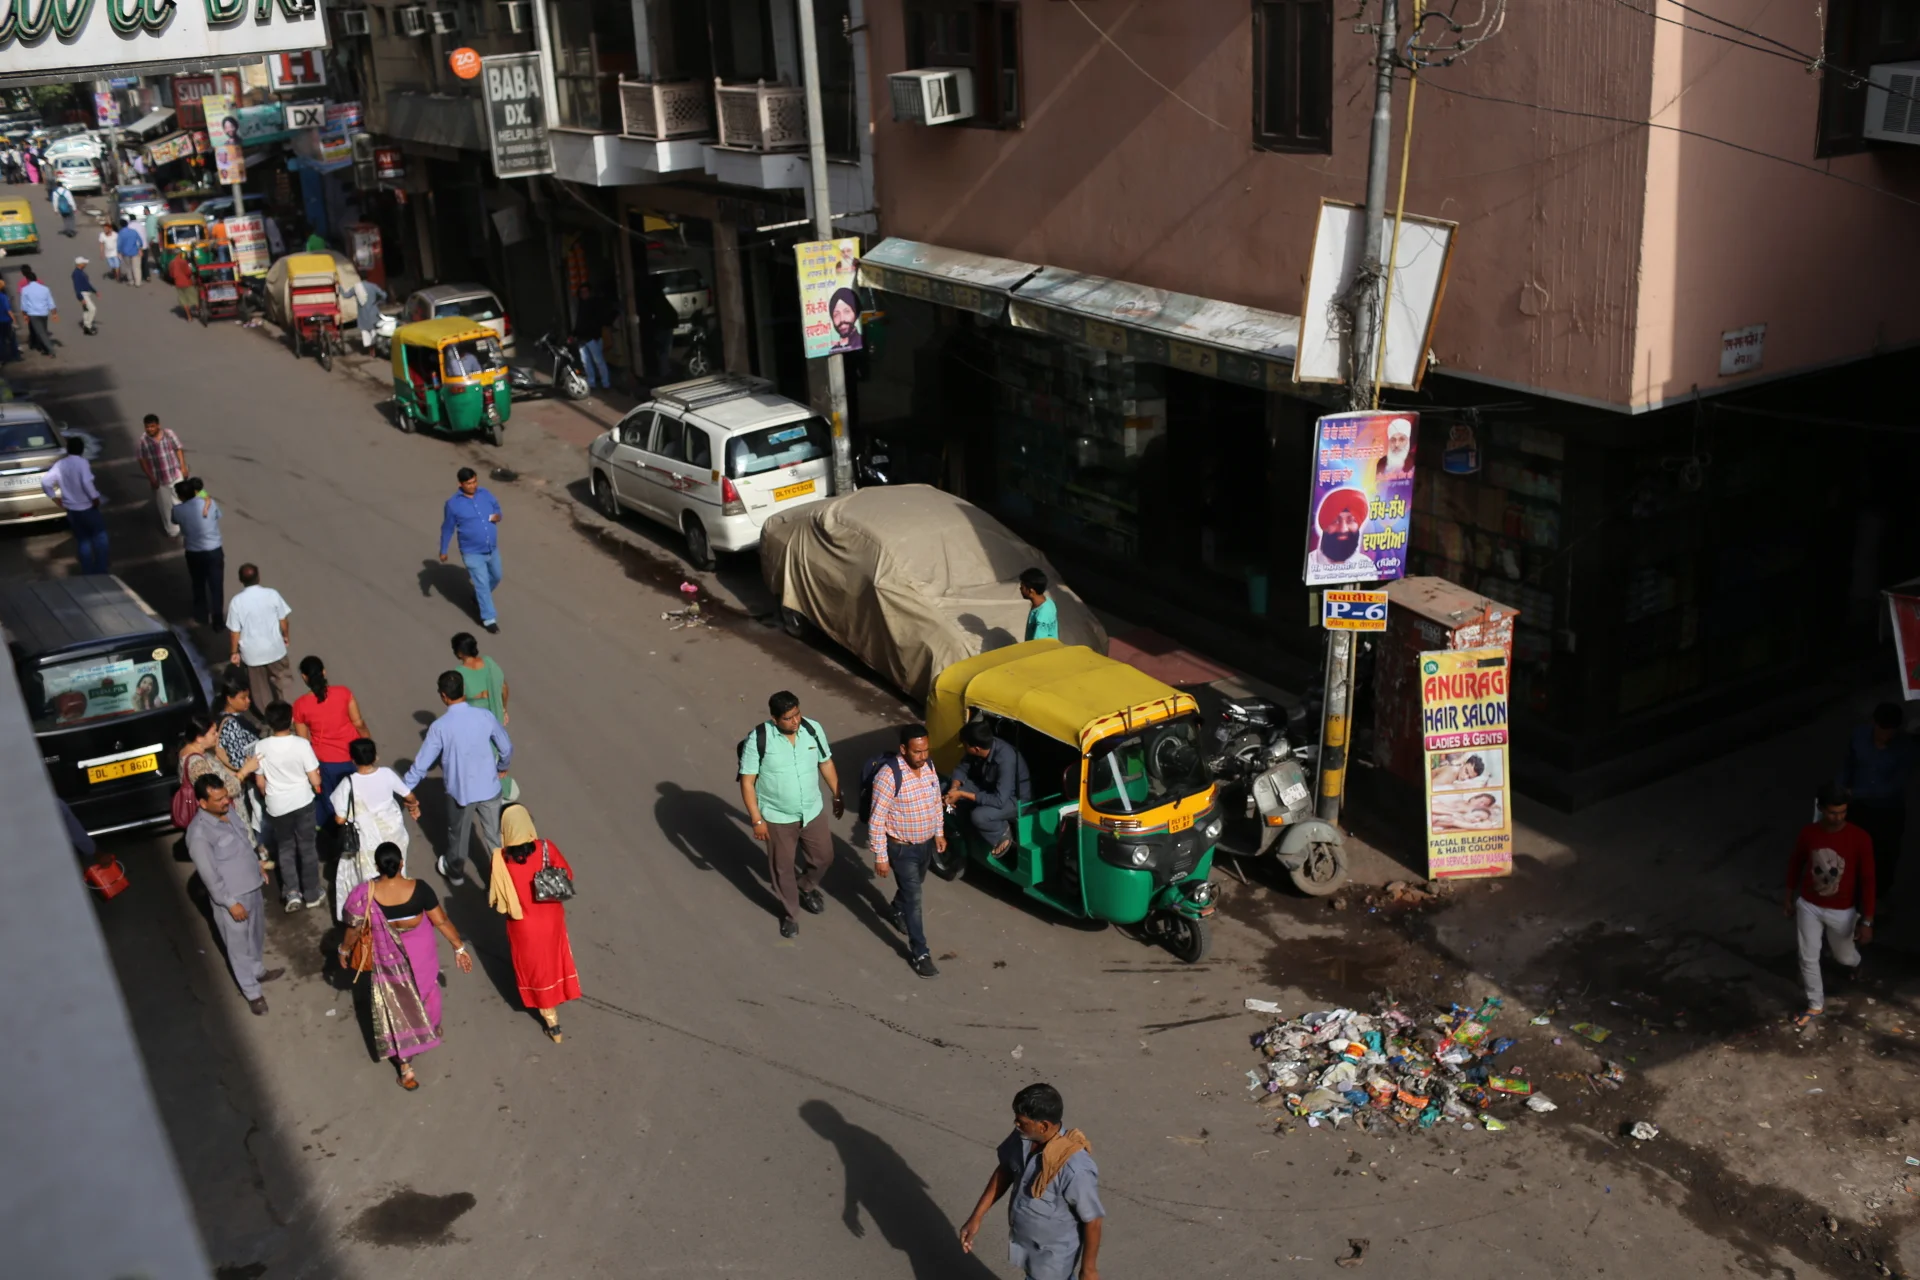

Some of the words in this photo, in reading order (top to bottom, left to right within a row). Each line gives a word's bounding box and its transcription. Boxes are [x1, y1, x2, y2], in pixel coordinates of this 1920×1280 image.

[488, 65, 540, 102] BABA
[294, 109, 320, 125] DX
[230, 221, 261, 233] IMAGE
[1369, 494, 1405, 520] ਲੱਖ-ਲੱਖ
[1327, 602, 1385, 620] P-6
[1424, 670, 1504, 704] ANURAG
[1424, 705, 1459, 733] HAIR
[1462, 701, 1506, 728] SALON
[1429, 736, 1461, 749] LADIES
[1463, 733, 1470, 747] &
[1472, 732, 1503, 745] GENTS
[95, 768, 108, 779] DL
[130, 758, 154, 771] 8607
[1430, 838, 1459, 848] FACIAL
[1461, 834, 1510, 845] BLEACHING
[1445, 845, 1466, 854] HAIR
[1468, 843, 1504, 852] COLOUR
